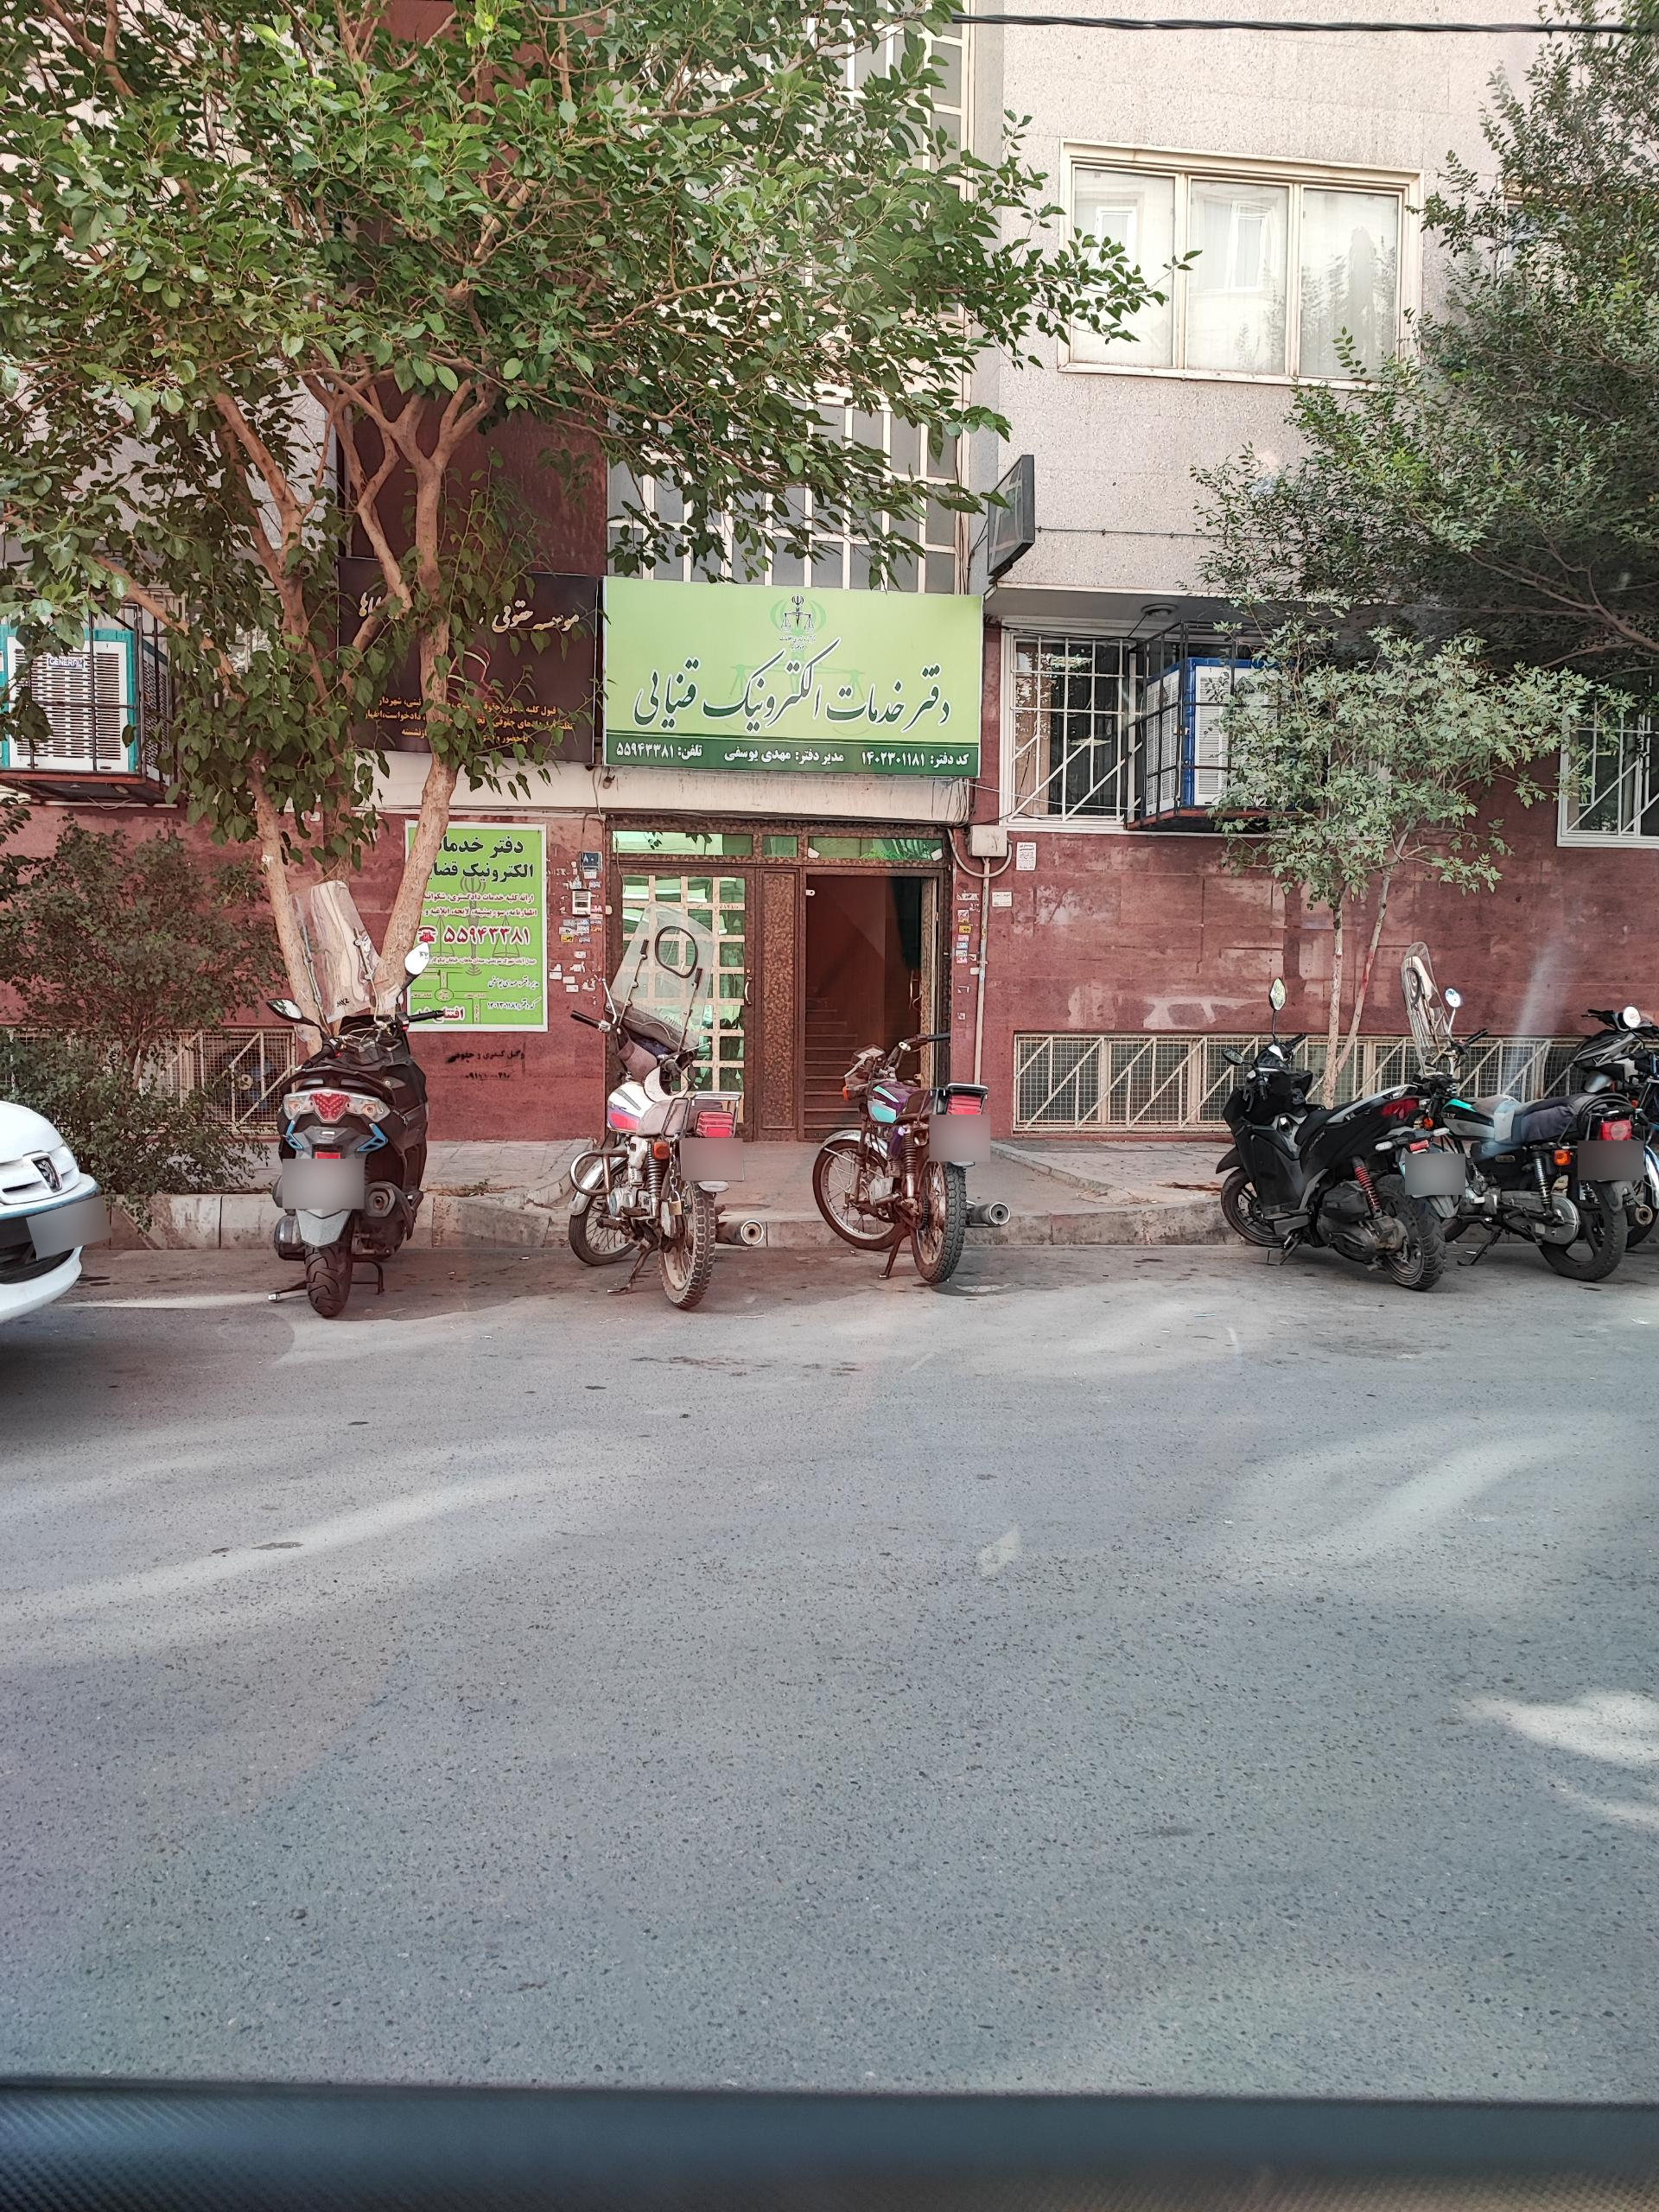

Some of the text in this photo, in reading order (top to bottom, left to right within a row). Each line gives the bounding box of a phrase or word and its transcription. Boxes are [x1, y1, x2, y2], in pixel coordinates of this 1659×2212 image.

[491, 600, 534, 633] حقوقی
[634, 637, 950, 733] دفتر خدمات الکترونیک قضایی
[378, 696, 402, 707] شهردار
[525, 705, 540, 715] کلیه
[540, 705, 557, 716] قبول
[401, 728, 428, 739] ازنشسته
[616, 741, 702, 760] تلفن: ۵۵۹۴۳۳۸۱
[724, 746, 844, 766] مدیر دفتر: مهدی یوسفی
[861, 751, 969, 768] کد دفتر: ۱۴۰۲۳۰۱۱۸۱
[440, 836, 524, 859] دفتر خدما
[462, 862, 534, 882] الکترونیک
[482, 893, 504, 901] خدمات
[443, 926, 531, 944] ۵۵۹۴۳۳۸۱
